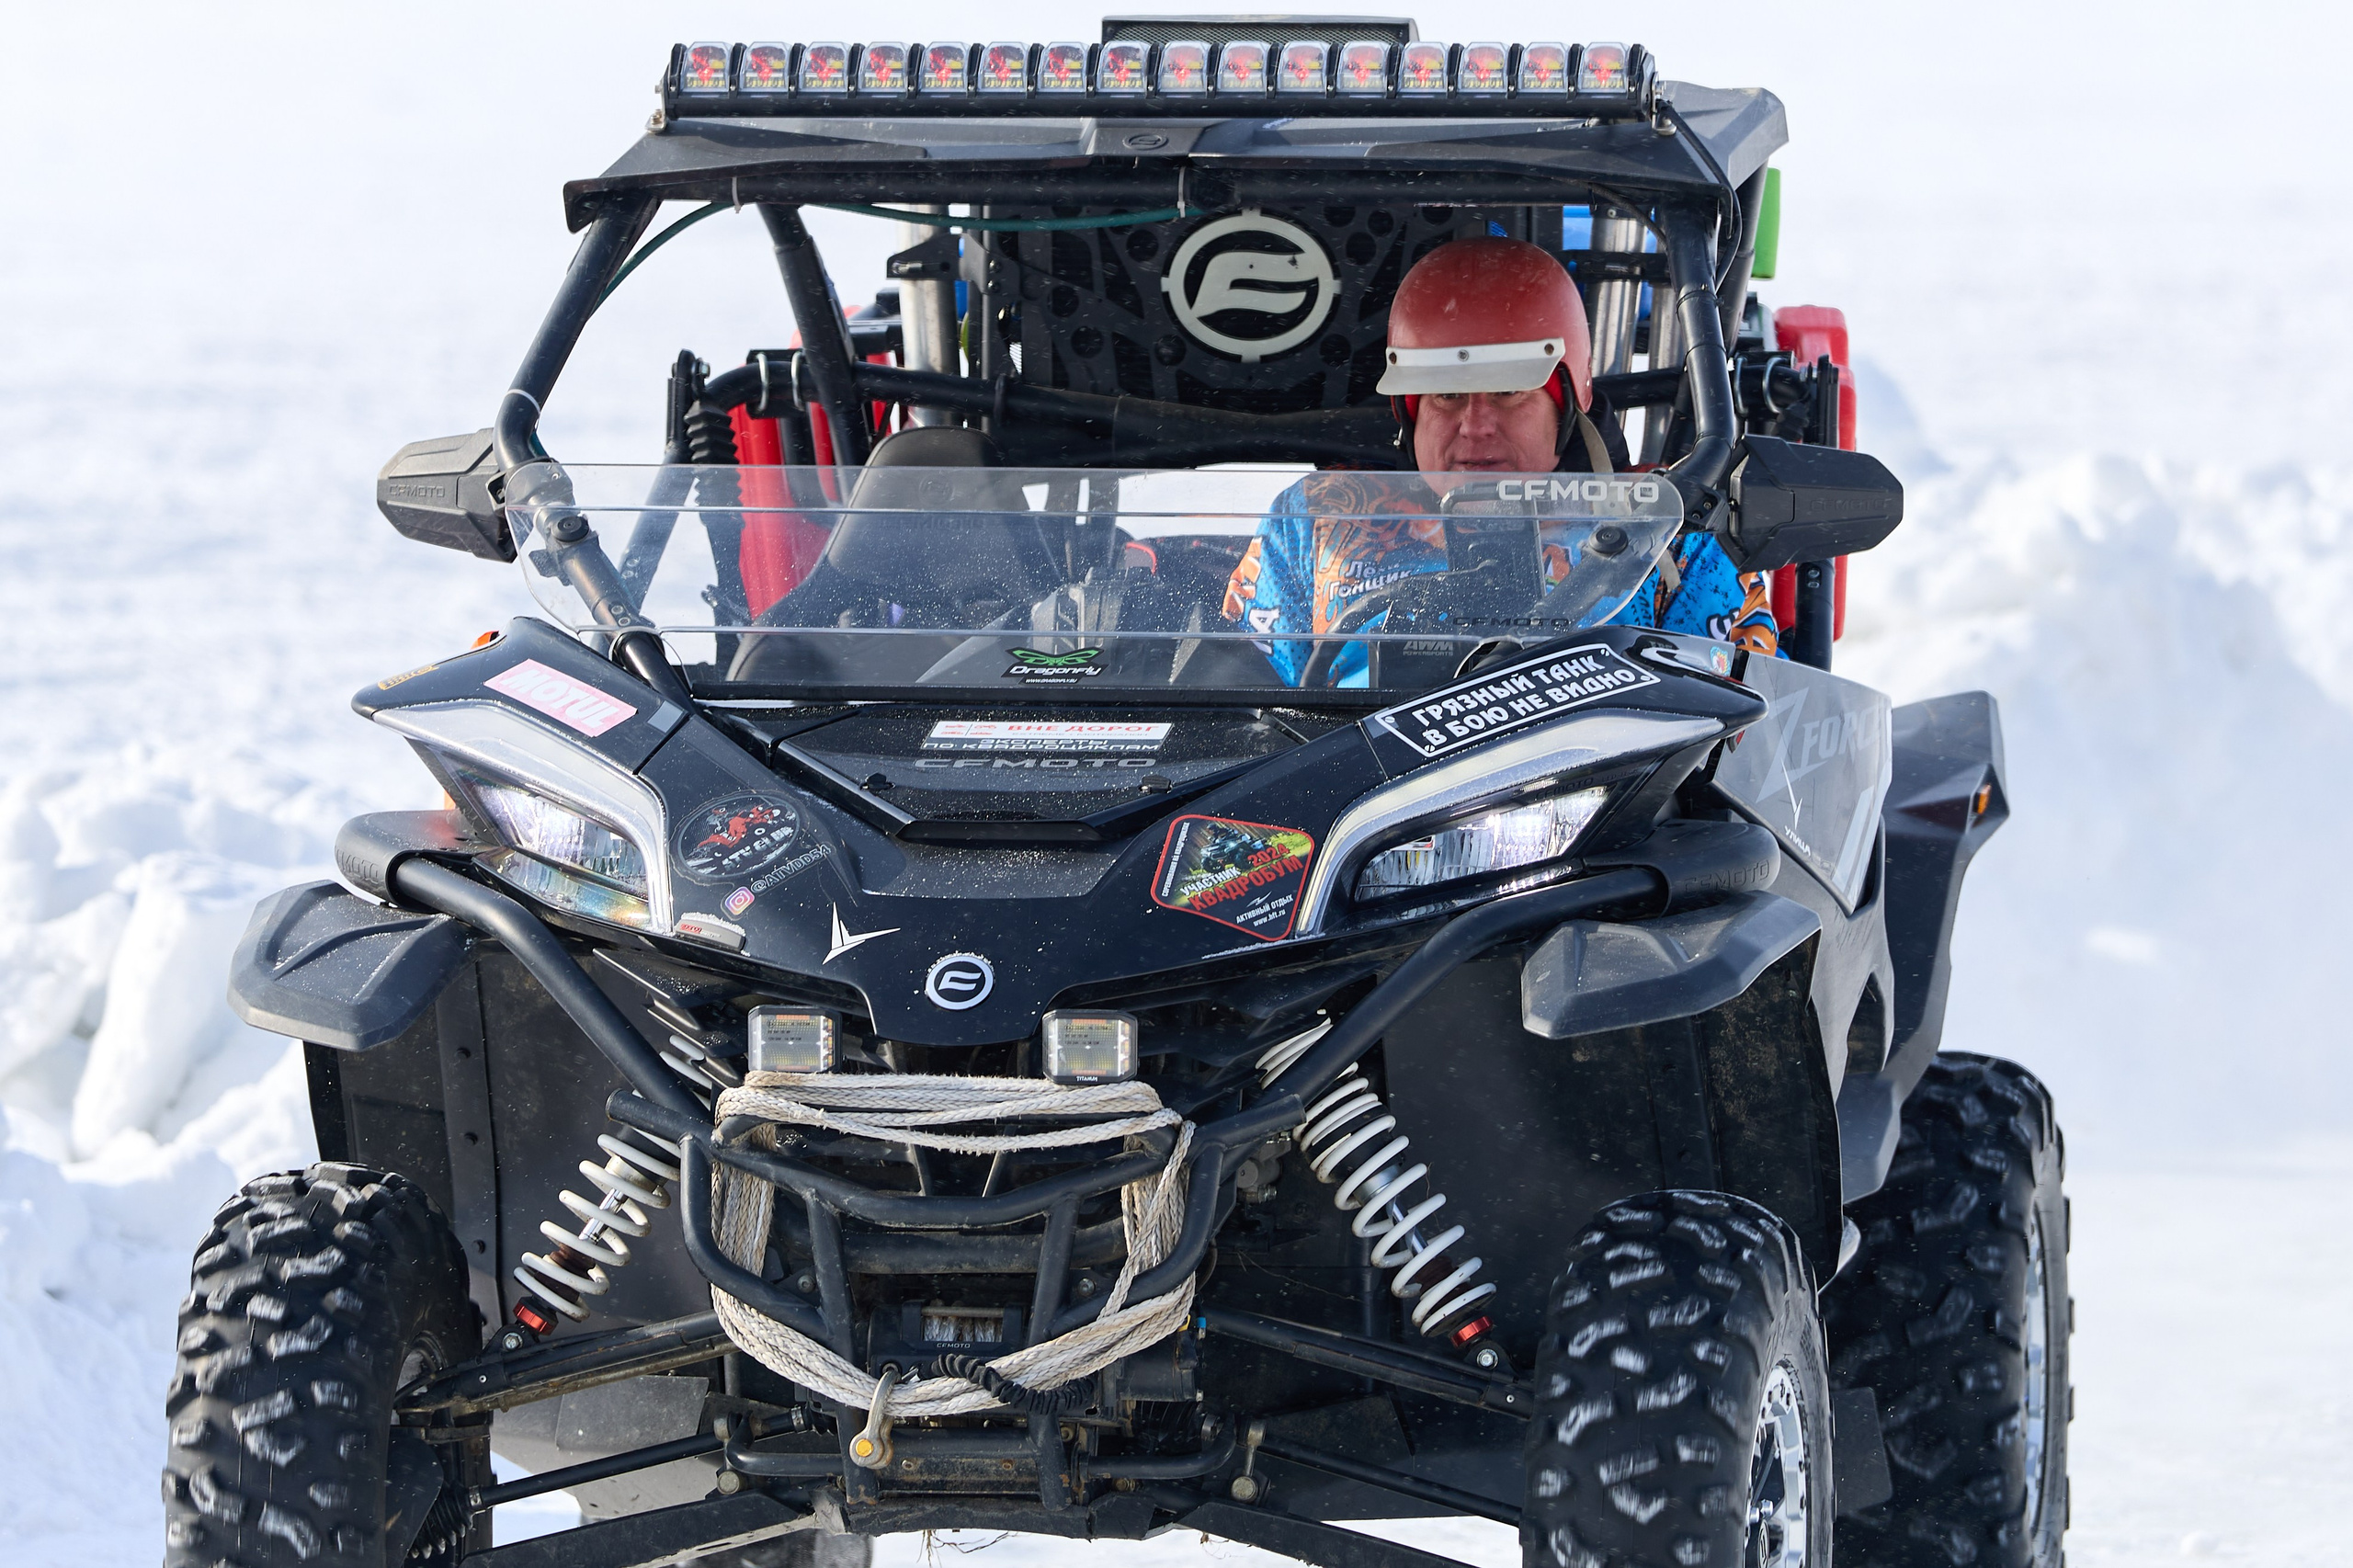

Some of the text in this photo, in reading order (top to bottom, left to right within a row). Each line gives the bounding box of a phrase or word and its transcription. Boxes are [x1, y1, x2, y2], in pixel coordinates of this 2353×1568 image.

[389, 483, 446, 498] CFMOTO
[1498, 479, 1659, 503] CFMOTO
[1329, 570, 1412, 602] Гонщик
[1452, 617, 1570, 627] CFMOTO
[1403, 641, 1454, 651] AWM
[1009, 665, 1102, 676] Dragonfly
[500, 668, 620, 729] MOTUL
[1411, 653, 1606, 727] ГРЯЗНЫЙ ТАНК
[1422, 668, 1636, 747] В БОЮ НЕ ВИДНО
[1065, 724, 1160, 733] ДОРОГ
[914, 758, 1156, 769] CFMOTO
[750, 843, 833, 893] @ATVDD54
[1247, 843, 1290, 868] 2024
[1180, 866, 1242, 896] УЧАСТНИК
[1188, 855, 1304, 912] КВАДРОБУМ
[1235, 893, 1294, 924] АКТИВНЫЙ ОТДЫХ
